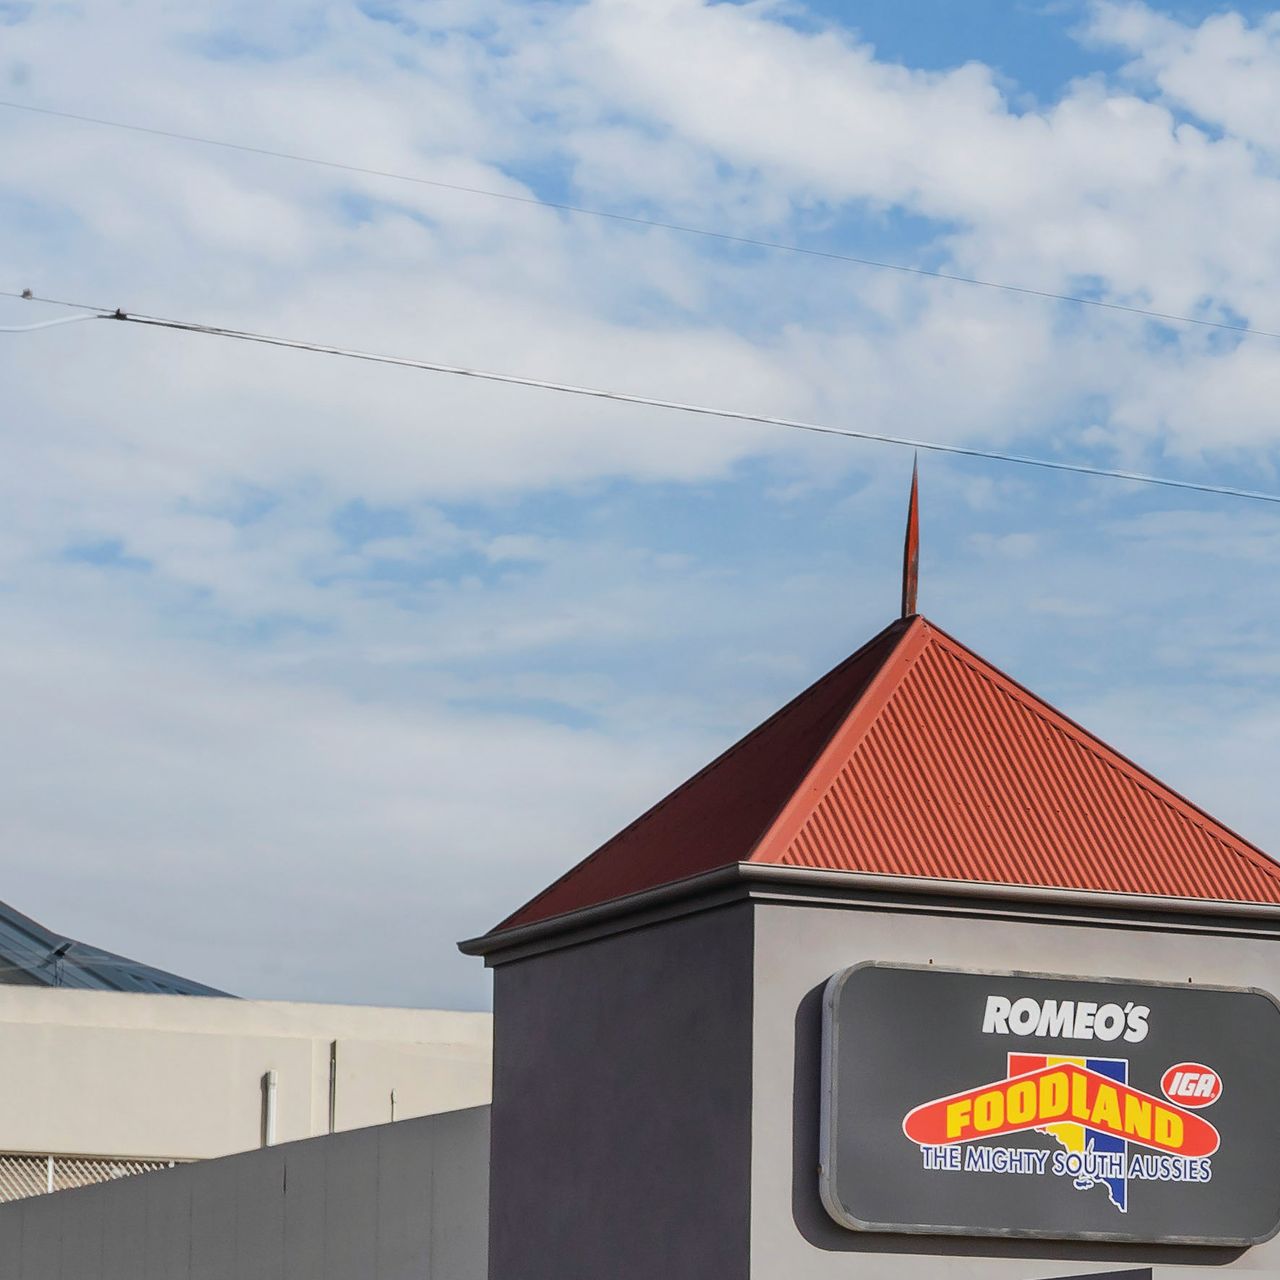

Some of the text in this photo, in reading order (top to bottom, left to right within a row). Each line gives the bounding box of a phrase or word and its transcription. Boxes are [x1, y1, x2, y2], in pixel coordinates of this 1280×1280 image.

[982, 995, 1150, 1043] ROMEO'S
[1168, 1072, 1214, 1098] IGA
[945, 1070, 1185, 1149] FOODLAND
[921, 1145, 1212, 1182] THE MIGHTY SOUTH AUSSIES
